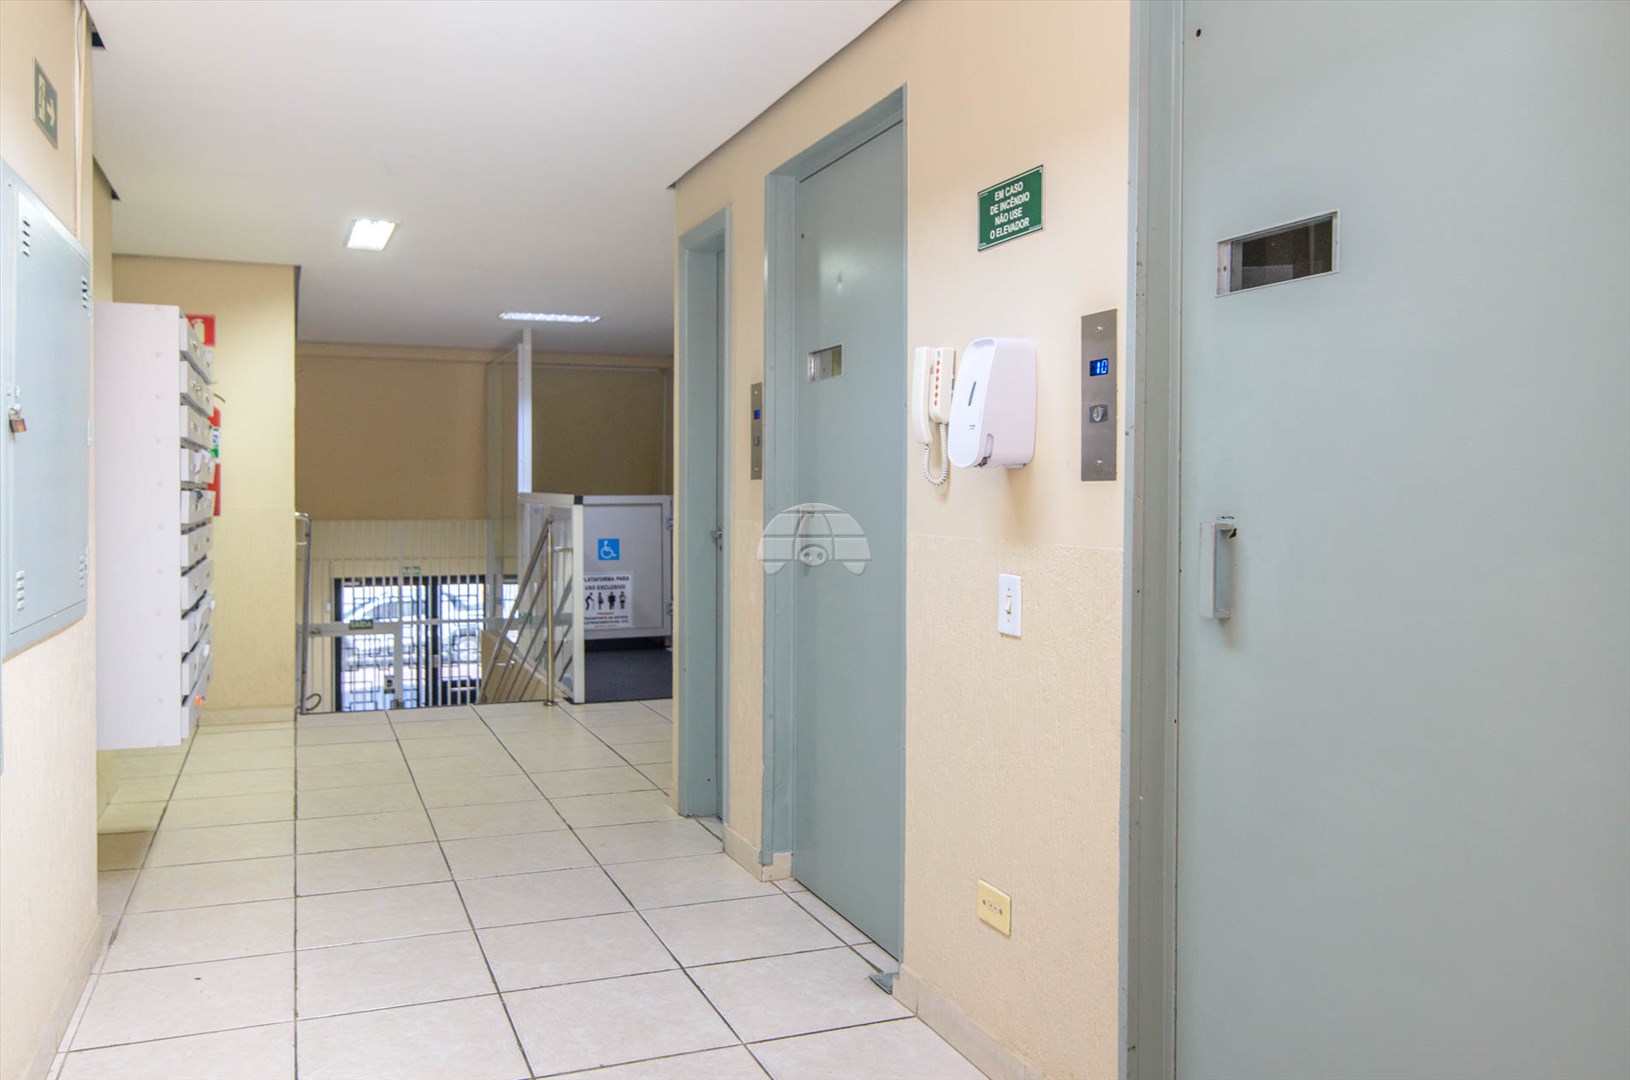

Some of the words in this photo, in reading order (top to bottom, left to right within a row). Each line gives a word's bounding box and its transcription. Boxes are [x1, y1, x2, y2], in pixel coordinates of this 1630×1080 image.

[994, 189, 1004, 201] EM
[1005, 181, 1024, 196] CASO
[990, 204, 999, 215] DE
[999, 192, 1030, 211] INCÊNDIO
[994, 212, 1008, 226] NÃO
[1009, 207, 1023, 219] USE
[990, 230, 995, 239] O
[996, 217, 1030, 237] ELEVADOR
